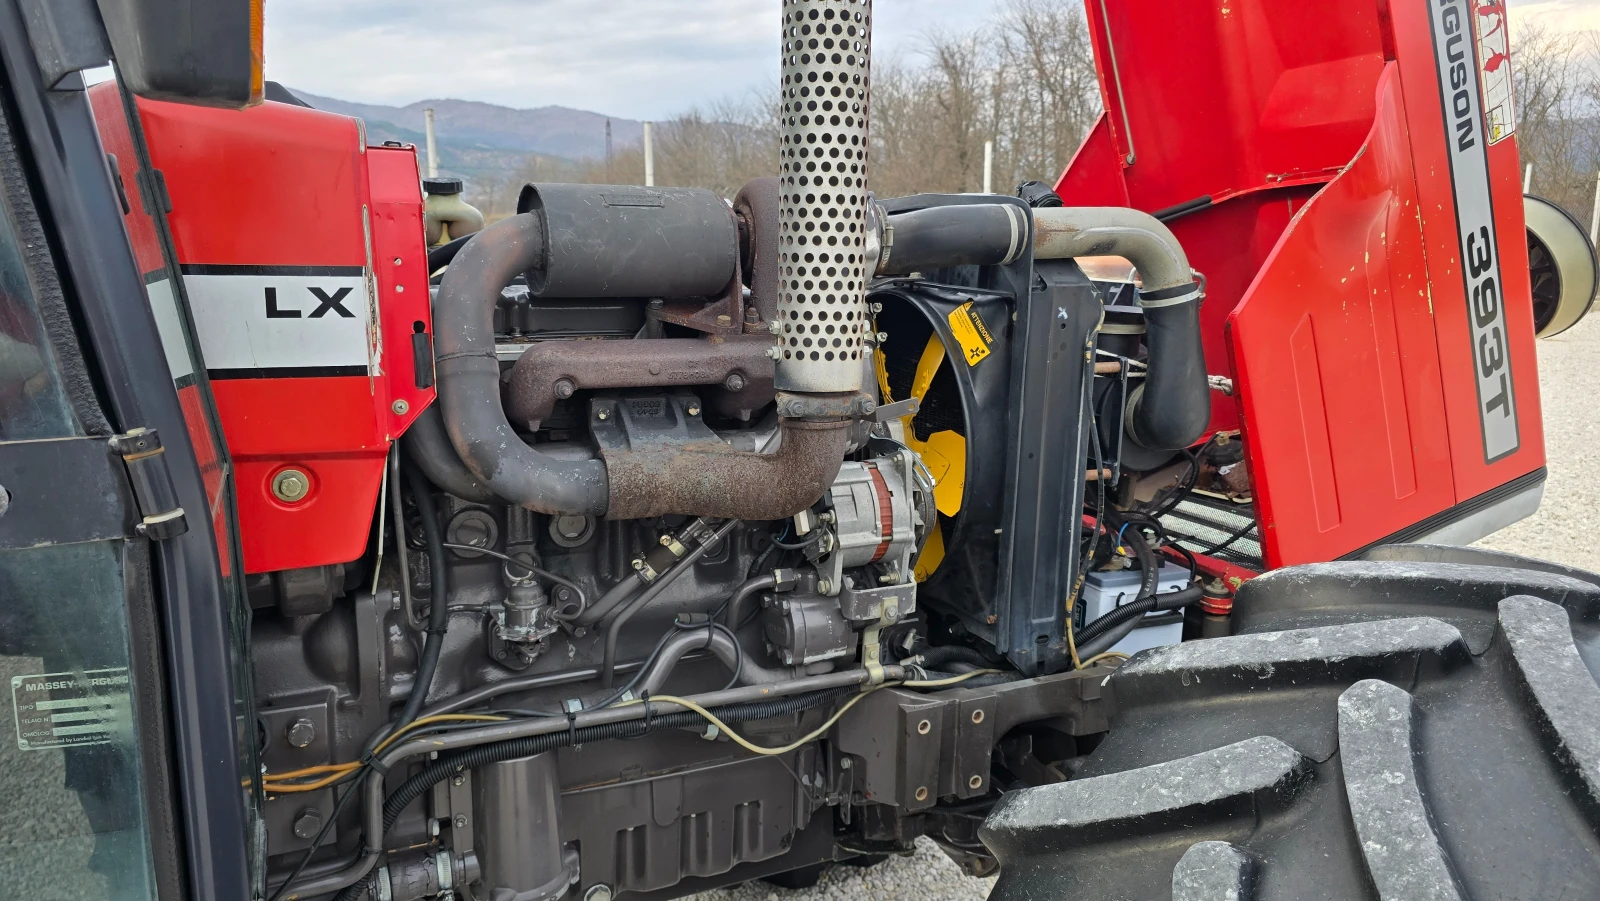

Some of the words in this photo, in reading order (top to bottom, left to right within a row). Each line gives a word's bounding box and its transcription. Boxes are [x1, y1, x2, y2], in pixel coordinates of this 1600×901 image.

[1440, 0, 1475, 153] GUSON
[1467, 225, 1510, 418] 393T
[264, 287, 356, 318] LX
[971, 311, 993, 344] ATTENZIONE
